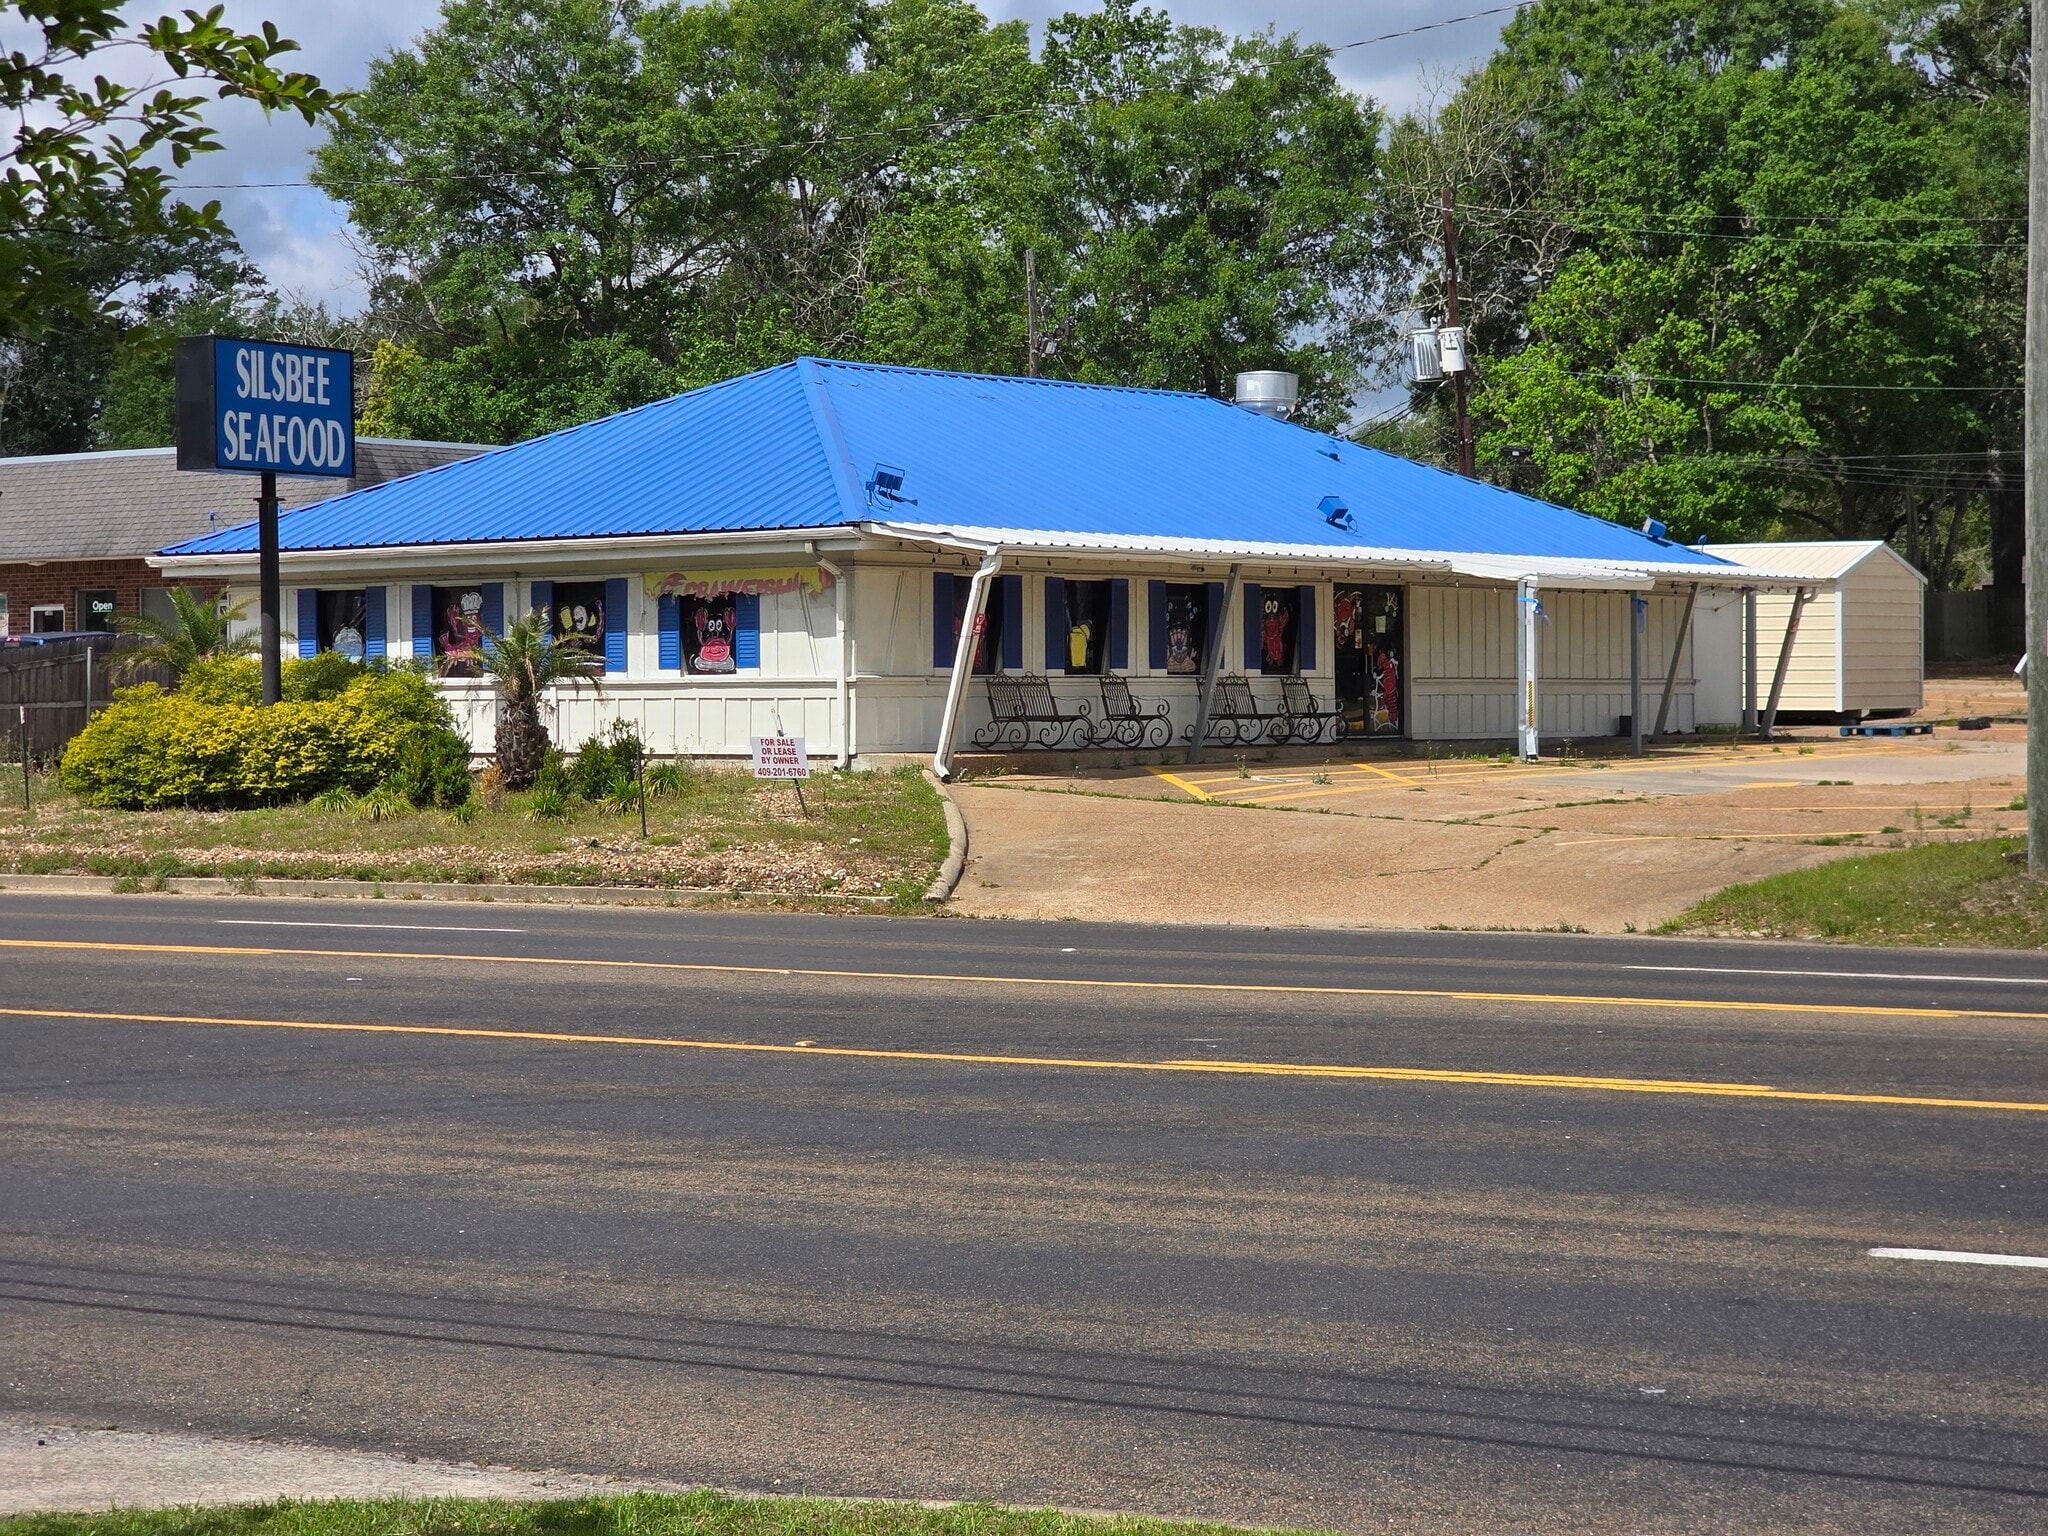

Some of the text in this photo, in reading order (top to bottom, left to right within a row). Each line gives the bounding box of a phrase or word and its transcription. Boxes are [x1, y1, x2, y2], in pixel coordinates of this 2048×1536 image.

[236, 347, 331, 406] SILSBEE
[223, 409, 346, 468] SEAFOOD
[92, 600, 113, 612] Open
[760, 738, 796, 747] FOR SALE
[772, 757, 800, 765] OWNER
[757, 767, 807, 777] 409-201-6760
